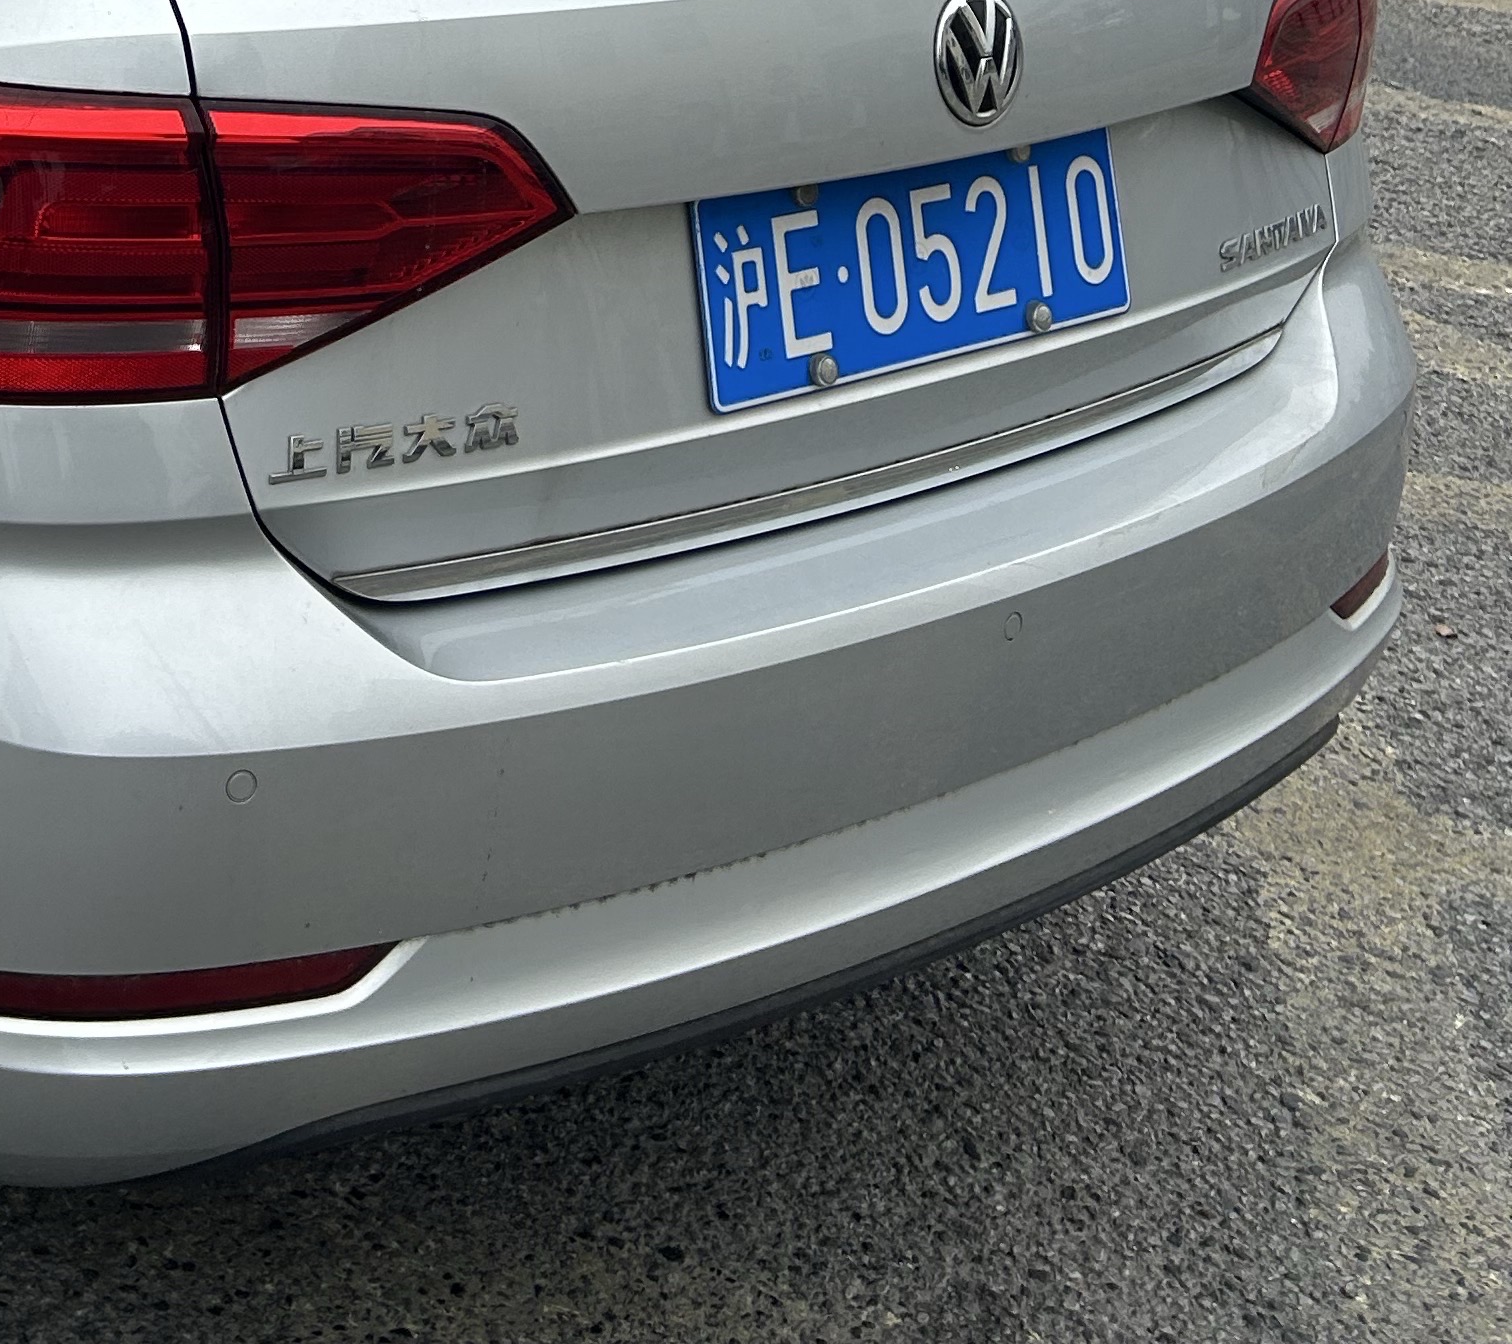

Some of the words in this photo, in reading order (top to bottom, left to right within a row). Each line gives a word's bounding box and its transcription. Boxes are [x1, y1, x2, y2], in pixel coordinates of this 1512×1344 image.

[713, 154, 1116, 370] 沪E·05210
[268, 402, 520, 486] 上汽大众
